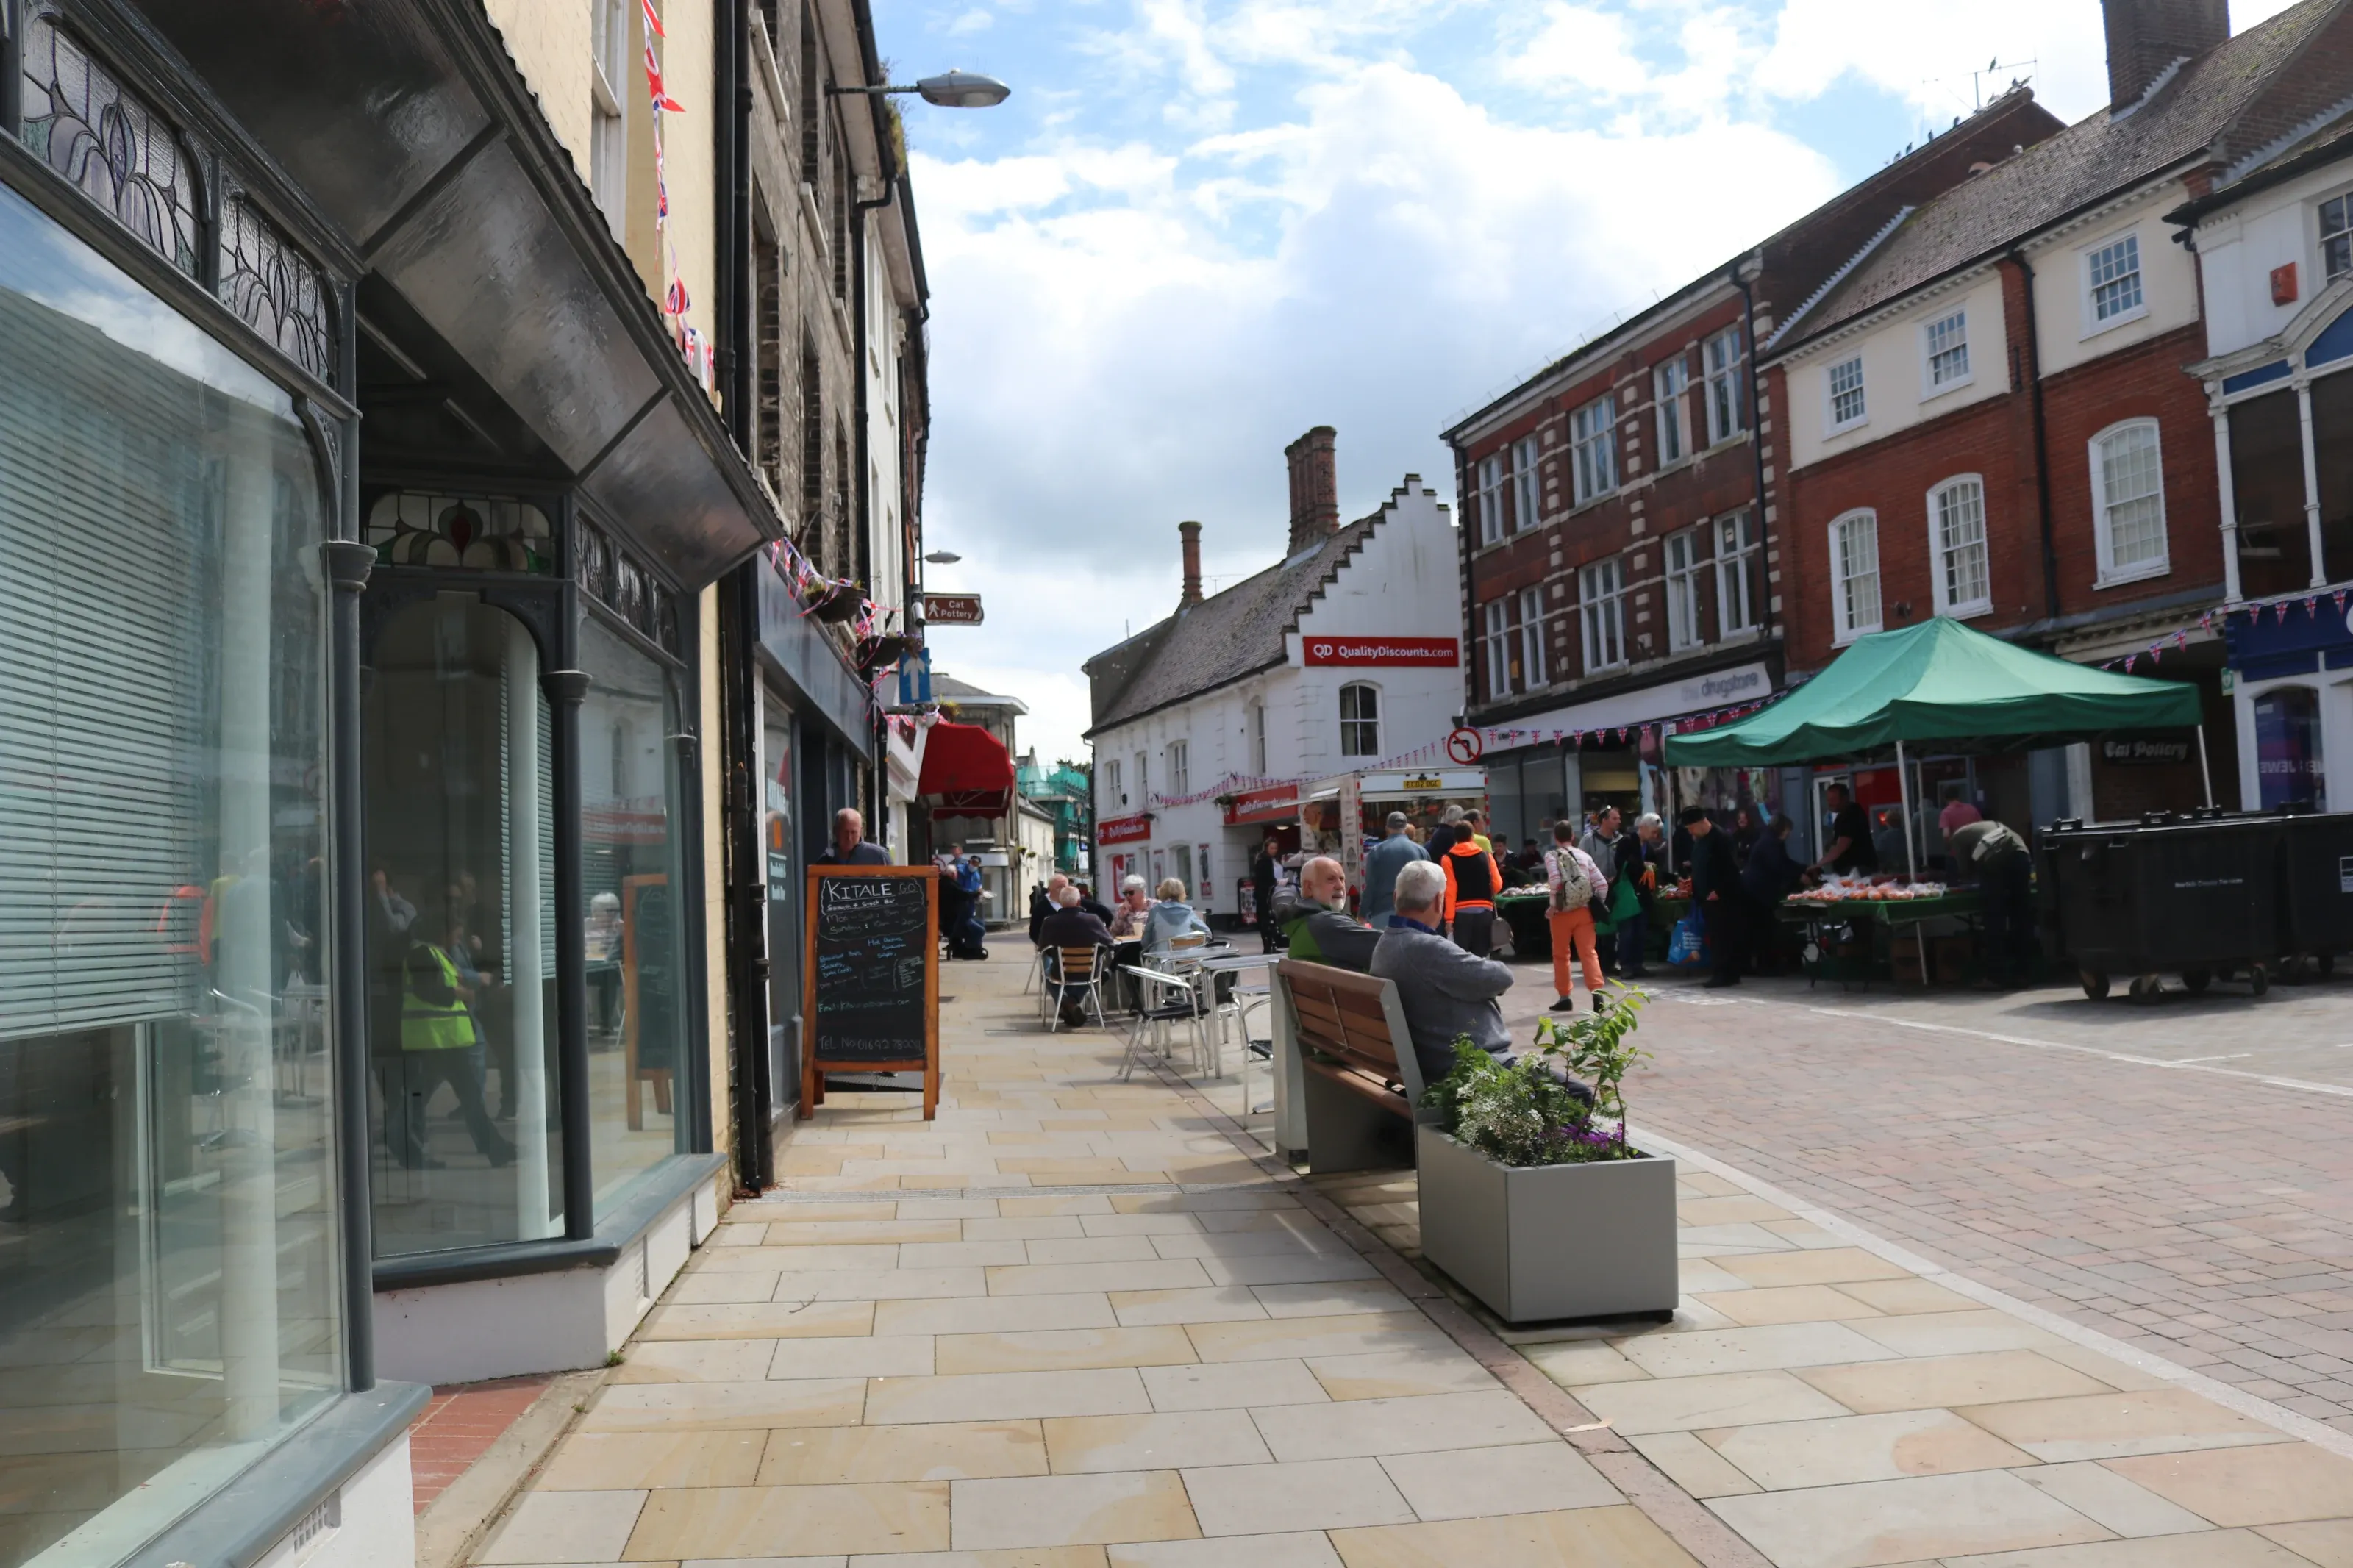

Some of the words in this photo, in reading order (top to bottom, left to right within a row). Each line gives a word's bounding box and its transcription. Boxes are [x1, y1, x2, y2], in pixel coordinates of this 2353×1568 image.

[949, 600, 964, 609] Cat
[941, 609, 972, 619] Pottery
[1313, 644, 1333, 658] QD
[1338, 645, 1454, 659] QualityDiscounts.com
[827, 880, 893, 901] KITALE
